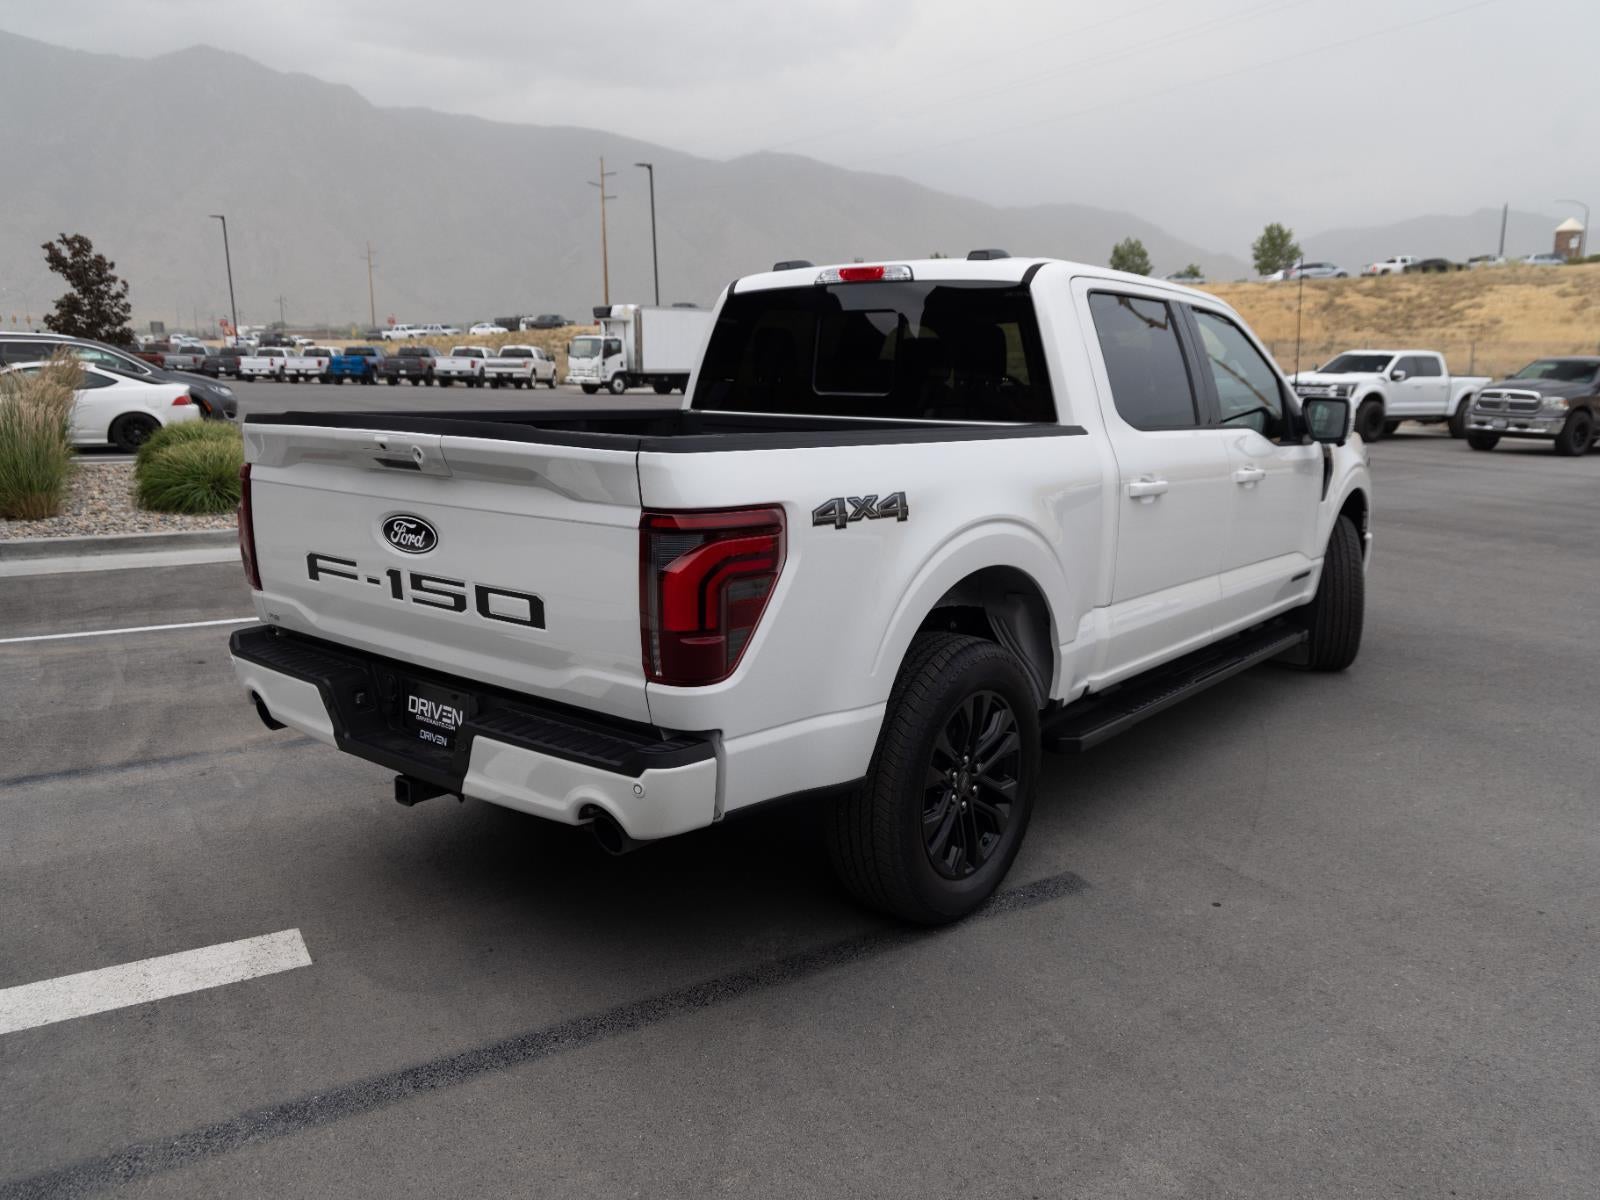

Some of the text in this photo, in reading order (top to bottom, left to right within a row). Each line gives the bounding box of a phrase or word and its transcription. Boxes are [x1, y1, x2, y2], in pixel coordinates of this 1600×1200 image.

[390, 519, 425, 548] Ford
[306, 552, 546, 630] F-150
[408, 695, 463, 727] DRIVEN
[420, 729, 447, 747] DRIVEN
